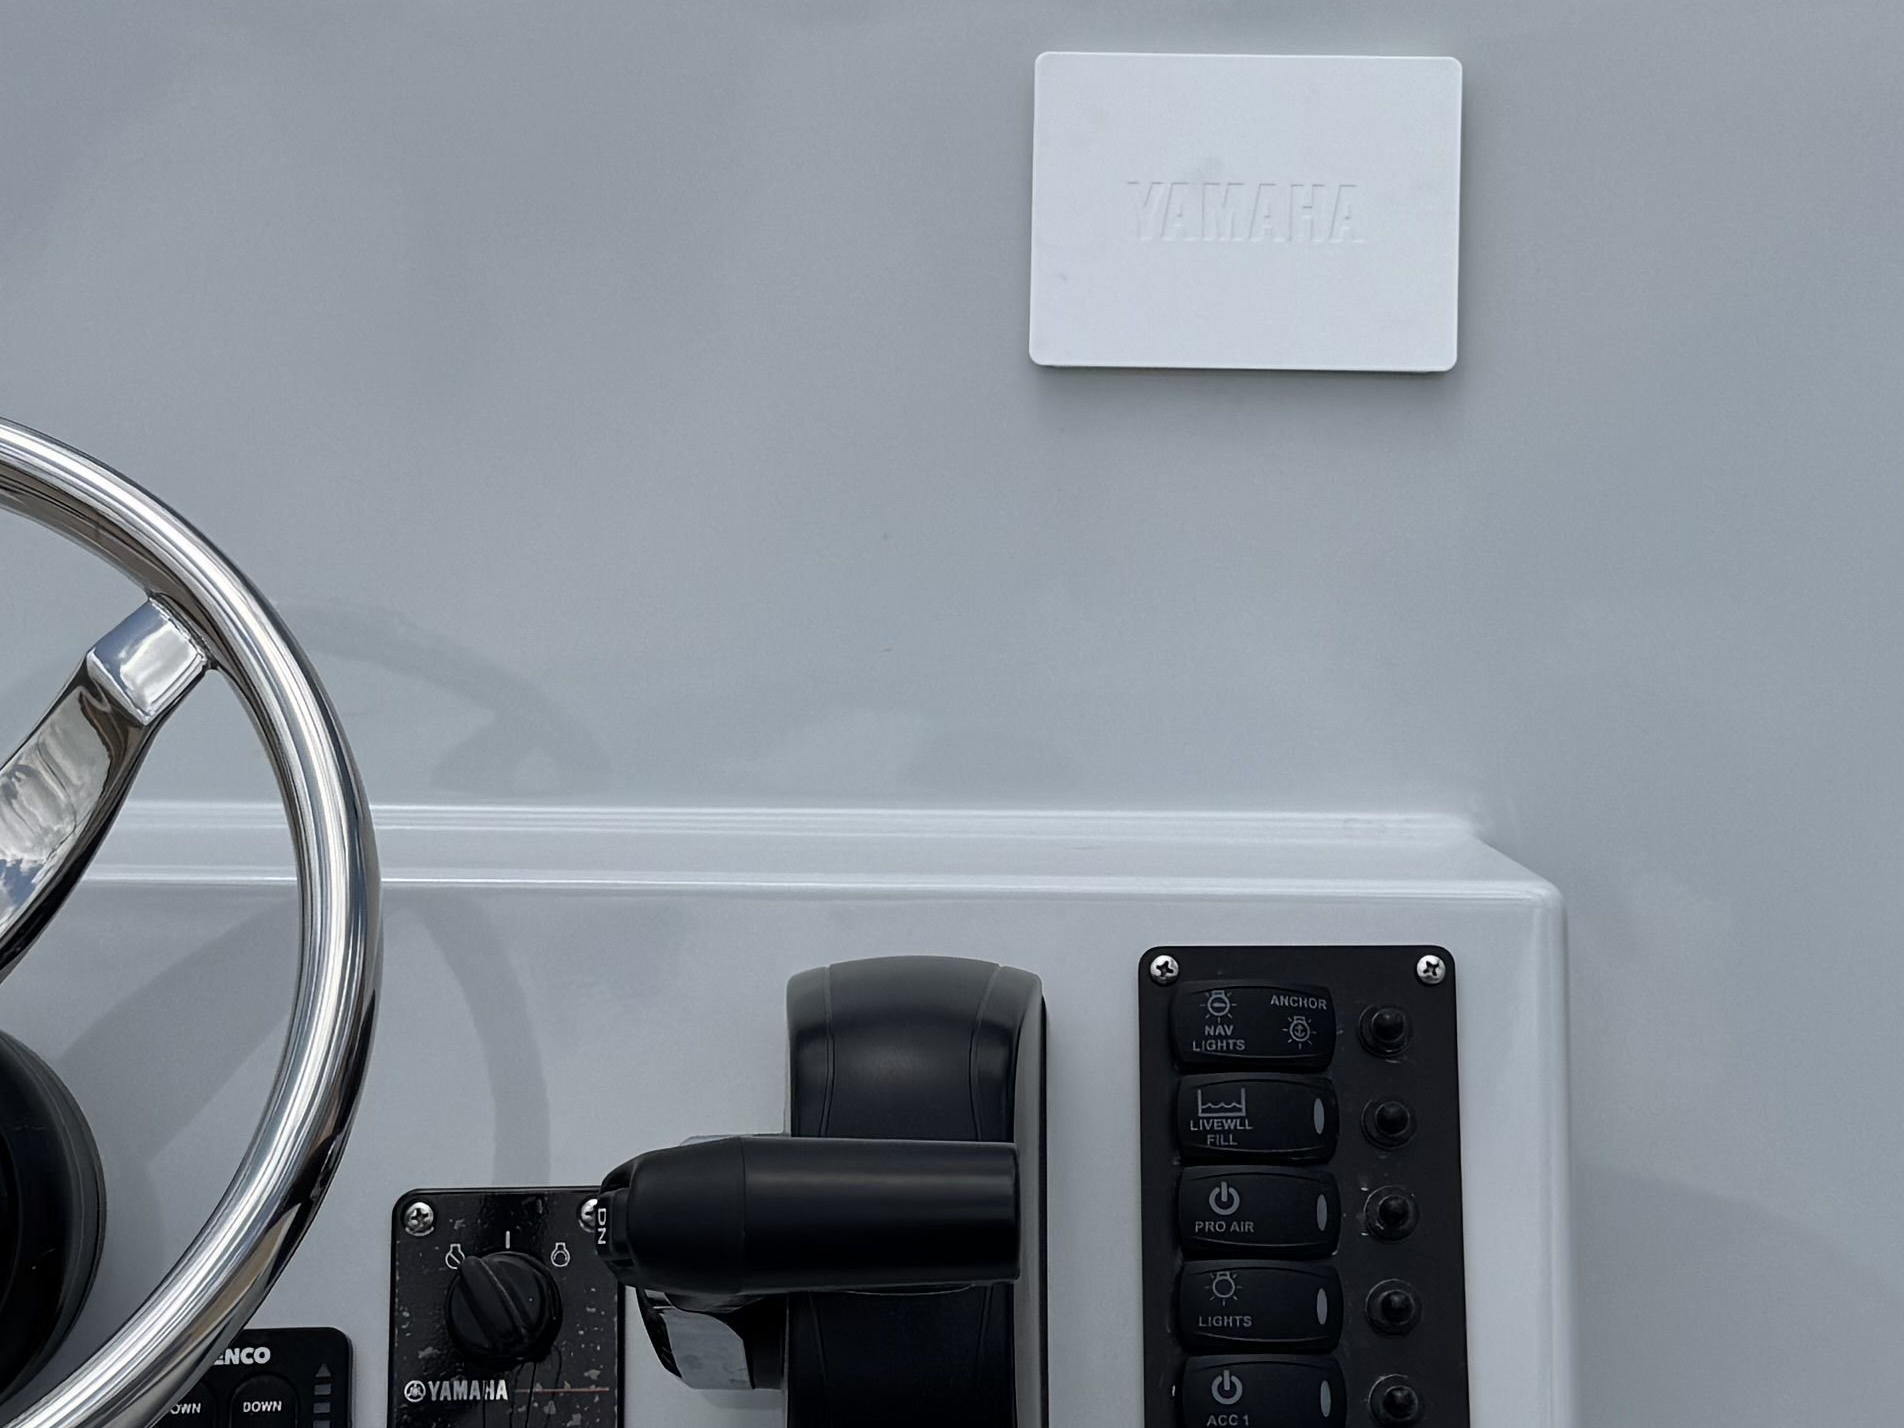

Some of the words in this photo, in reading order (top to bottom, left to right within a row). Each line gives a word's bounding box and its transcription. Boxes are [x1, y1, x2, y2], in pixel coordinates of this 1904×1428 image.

[1126, 181, 1368, 245] YAMAHA
[1270, 994, 1327, 1011] ANCHOR
[1204, 1024, 1234, 1037] NAV
[1192, 1039, 1246, 1052] LIGHTS
[1190, 1118, 1253, 1131] LIVEWLL
[1207, 1133, 1238, 1146] FILL
[597, 1207, 607, 1245] DN
[1194, 1221, 1226, 1233] PRO
[1229, 1221, 1255, 1233] AIR
[1197, 1315, 1252, 1328] LIGHTS
[428, 1379, 509, 1401] YAMAHA
[169, 1402, 201, 1415] OWN
[242, 1400, 282, 1413] DOWN
[1206, 1414, 1239, 1427] ACC
